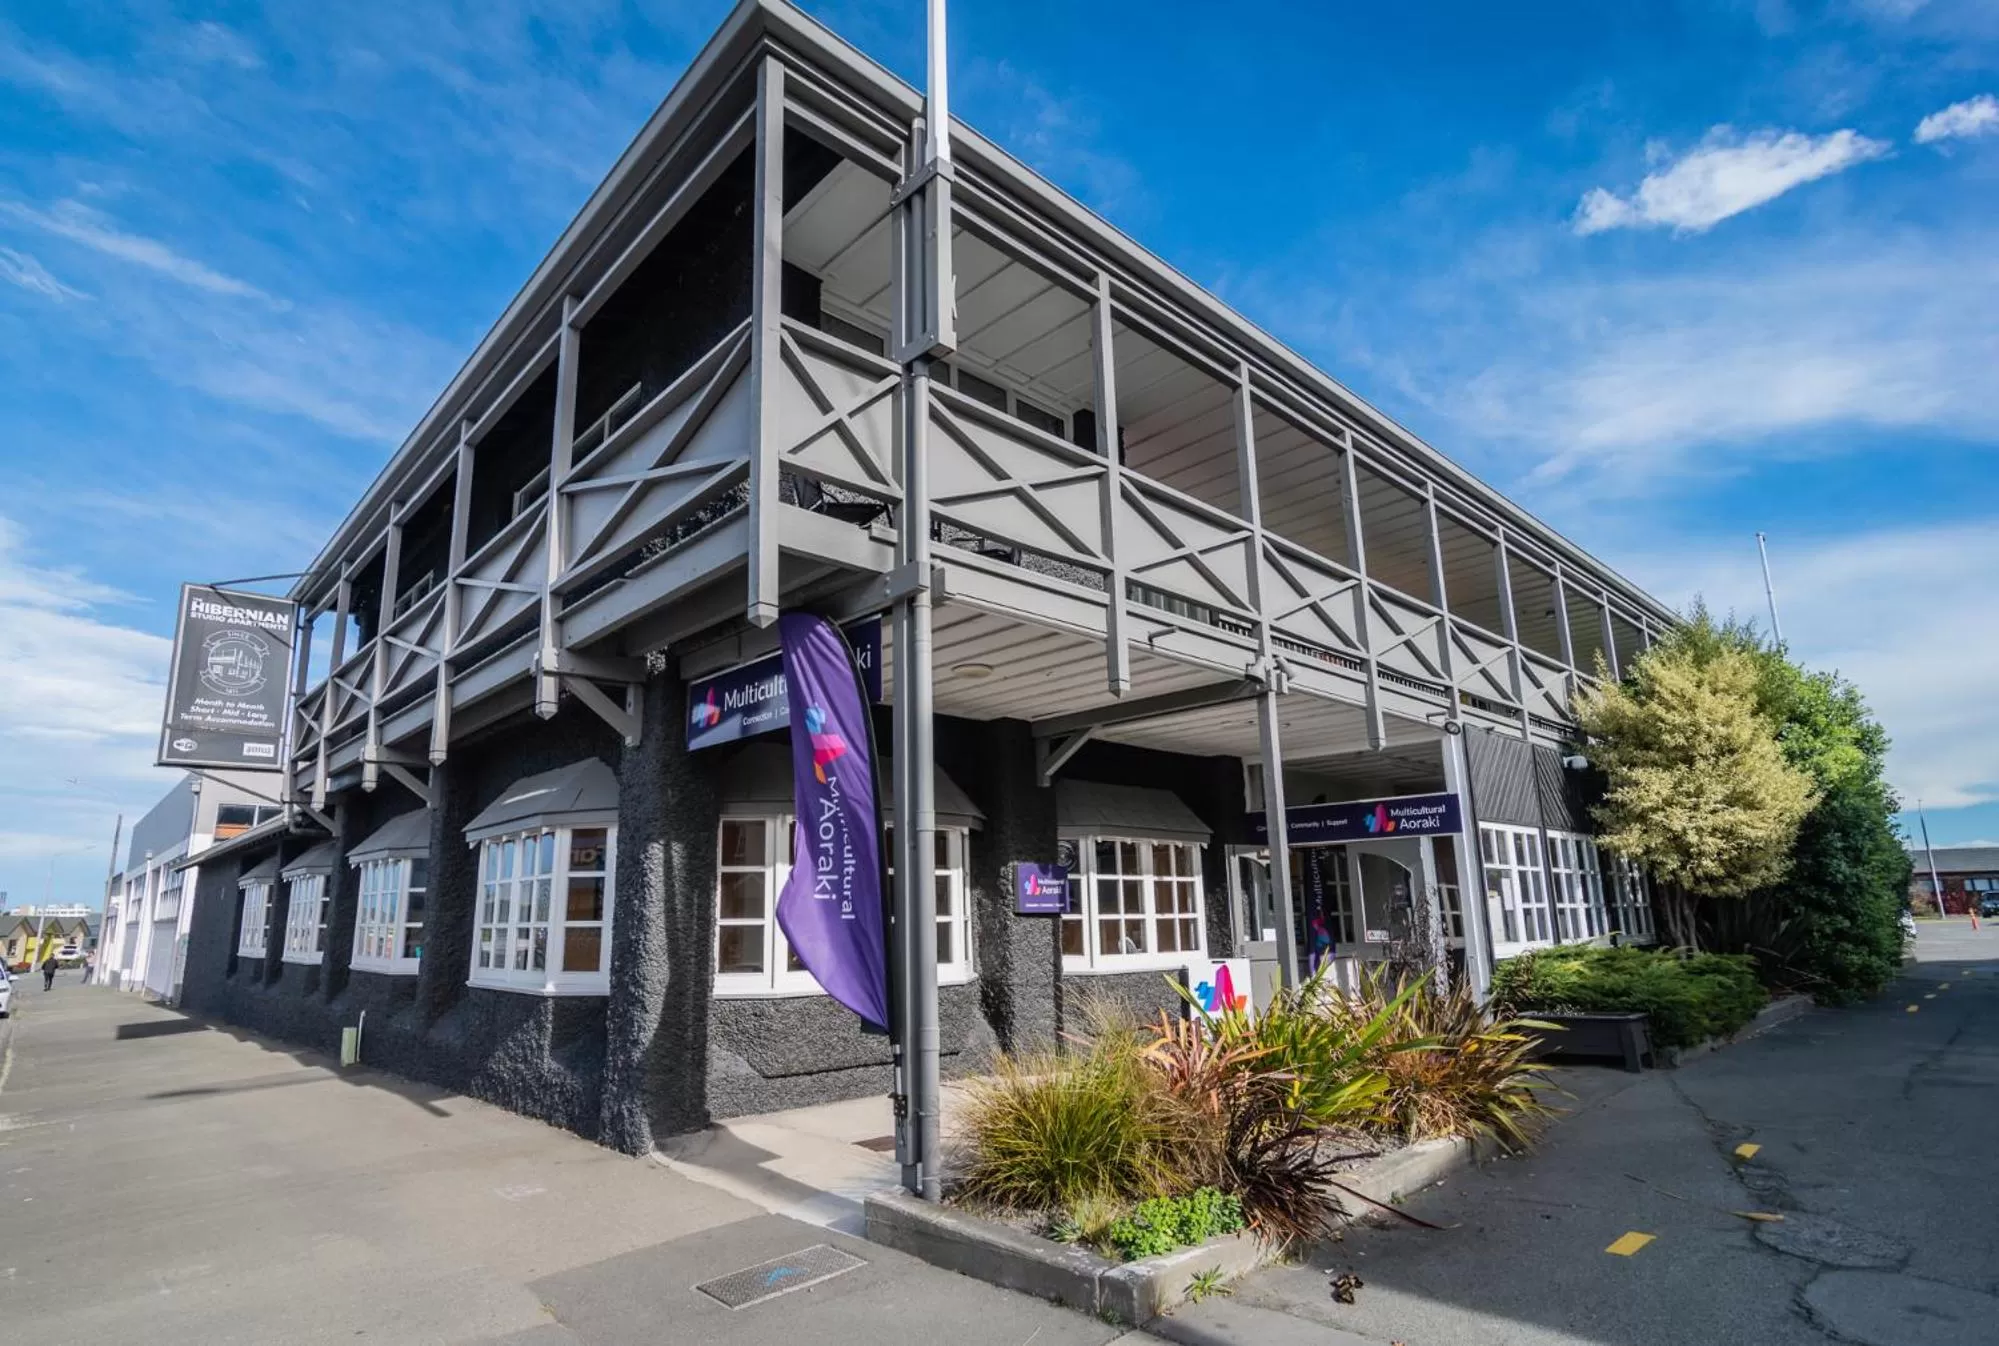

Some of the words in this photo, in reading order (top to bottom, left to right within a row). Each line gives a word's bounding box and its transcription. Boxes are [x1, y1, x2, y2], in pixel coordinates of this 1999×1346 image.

[191, 601, 289, 625] HIBERNIAN
[190, 611, 226, 623] STUDIO
[227, 617, 289, 632] APARTMENTS
[725, 674, 788, 712] Multicult
[194, 697, 224, 707] Month
[190, 705, 215, 714] Short
[221, 708, 241, 717] Mid
[180, 712, 203, 721] Term
[204, 714, 276, 728] Accommodation
[1391, 803, 1446, 817] Multicultural
[1400, 815, 1440, 830] Aoraki
[813, 798, 838, 900] Aoraki
